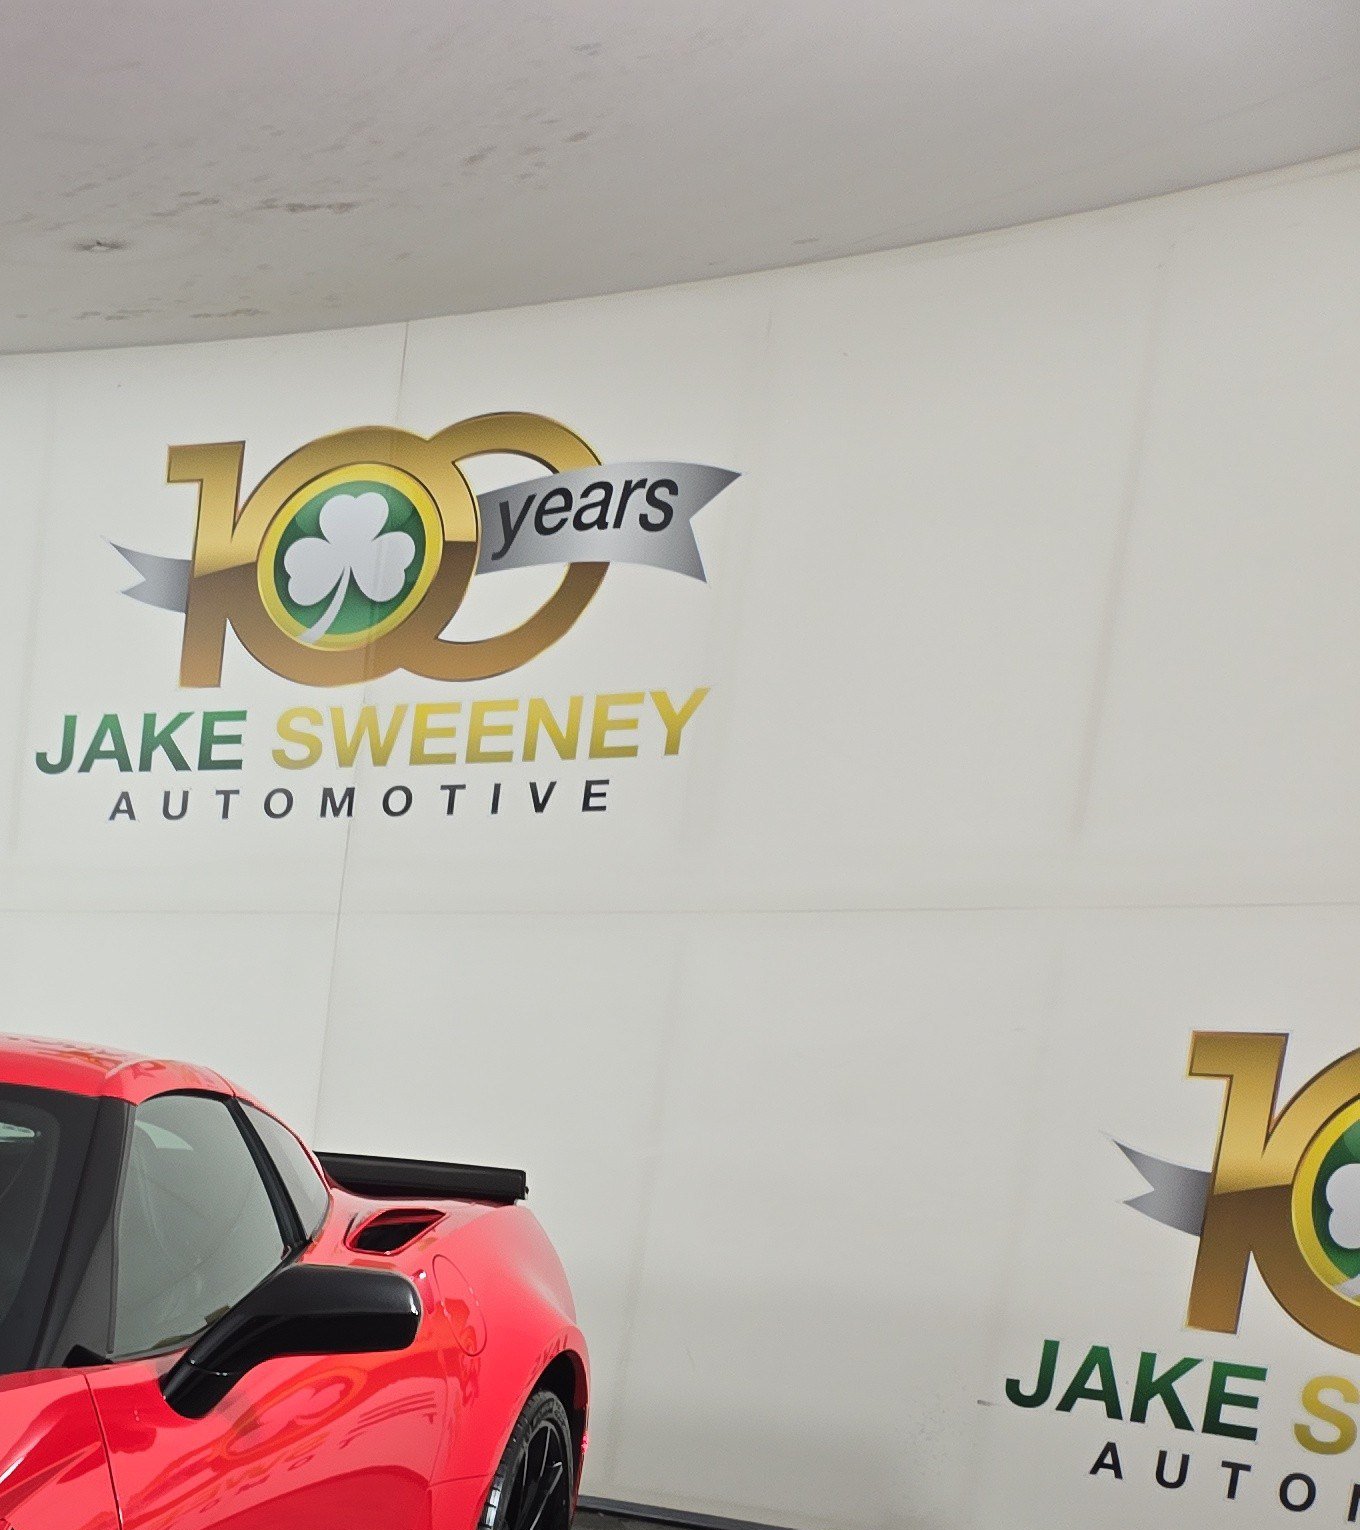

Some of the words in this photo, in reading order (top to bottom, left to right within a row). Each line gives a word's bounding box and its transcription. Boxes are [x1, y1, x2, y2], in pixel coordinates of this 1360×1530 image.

[166, 411, 610, 689] 100
[490, 477, 679, 560] years
[34, 709, 248, 775] JAKE
[271, 687, 711, 771] SWEENEY
[109, 779, 610, 822] AUTOMOTIVE
[1005, 1339, 1268, 1442] JAKE
[1089, 1441, 1360, 1523] AUTO
